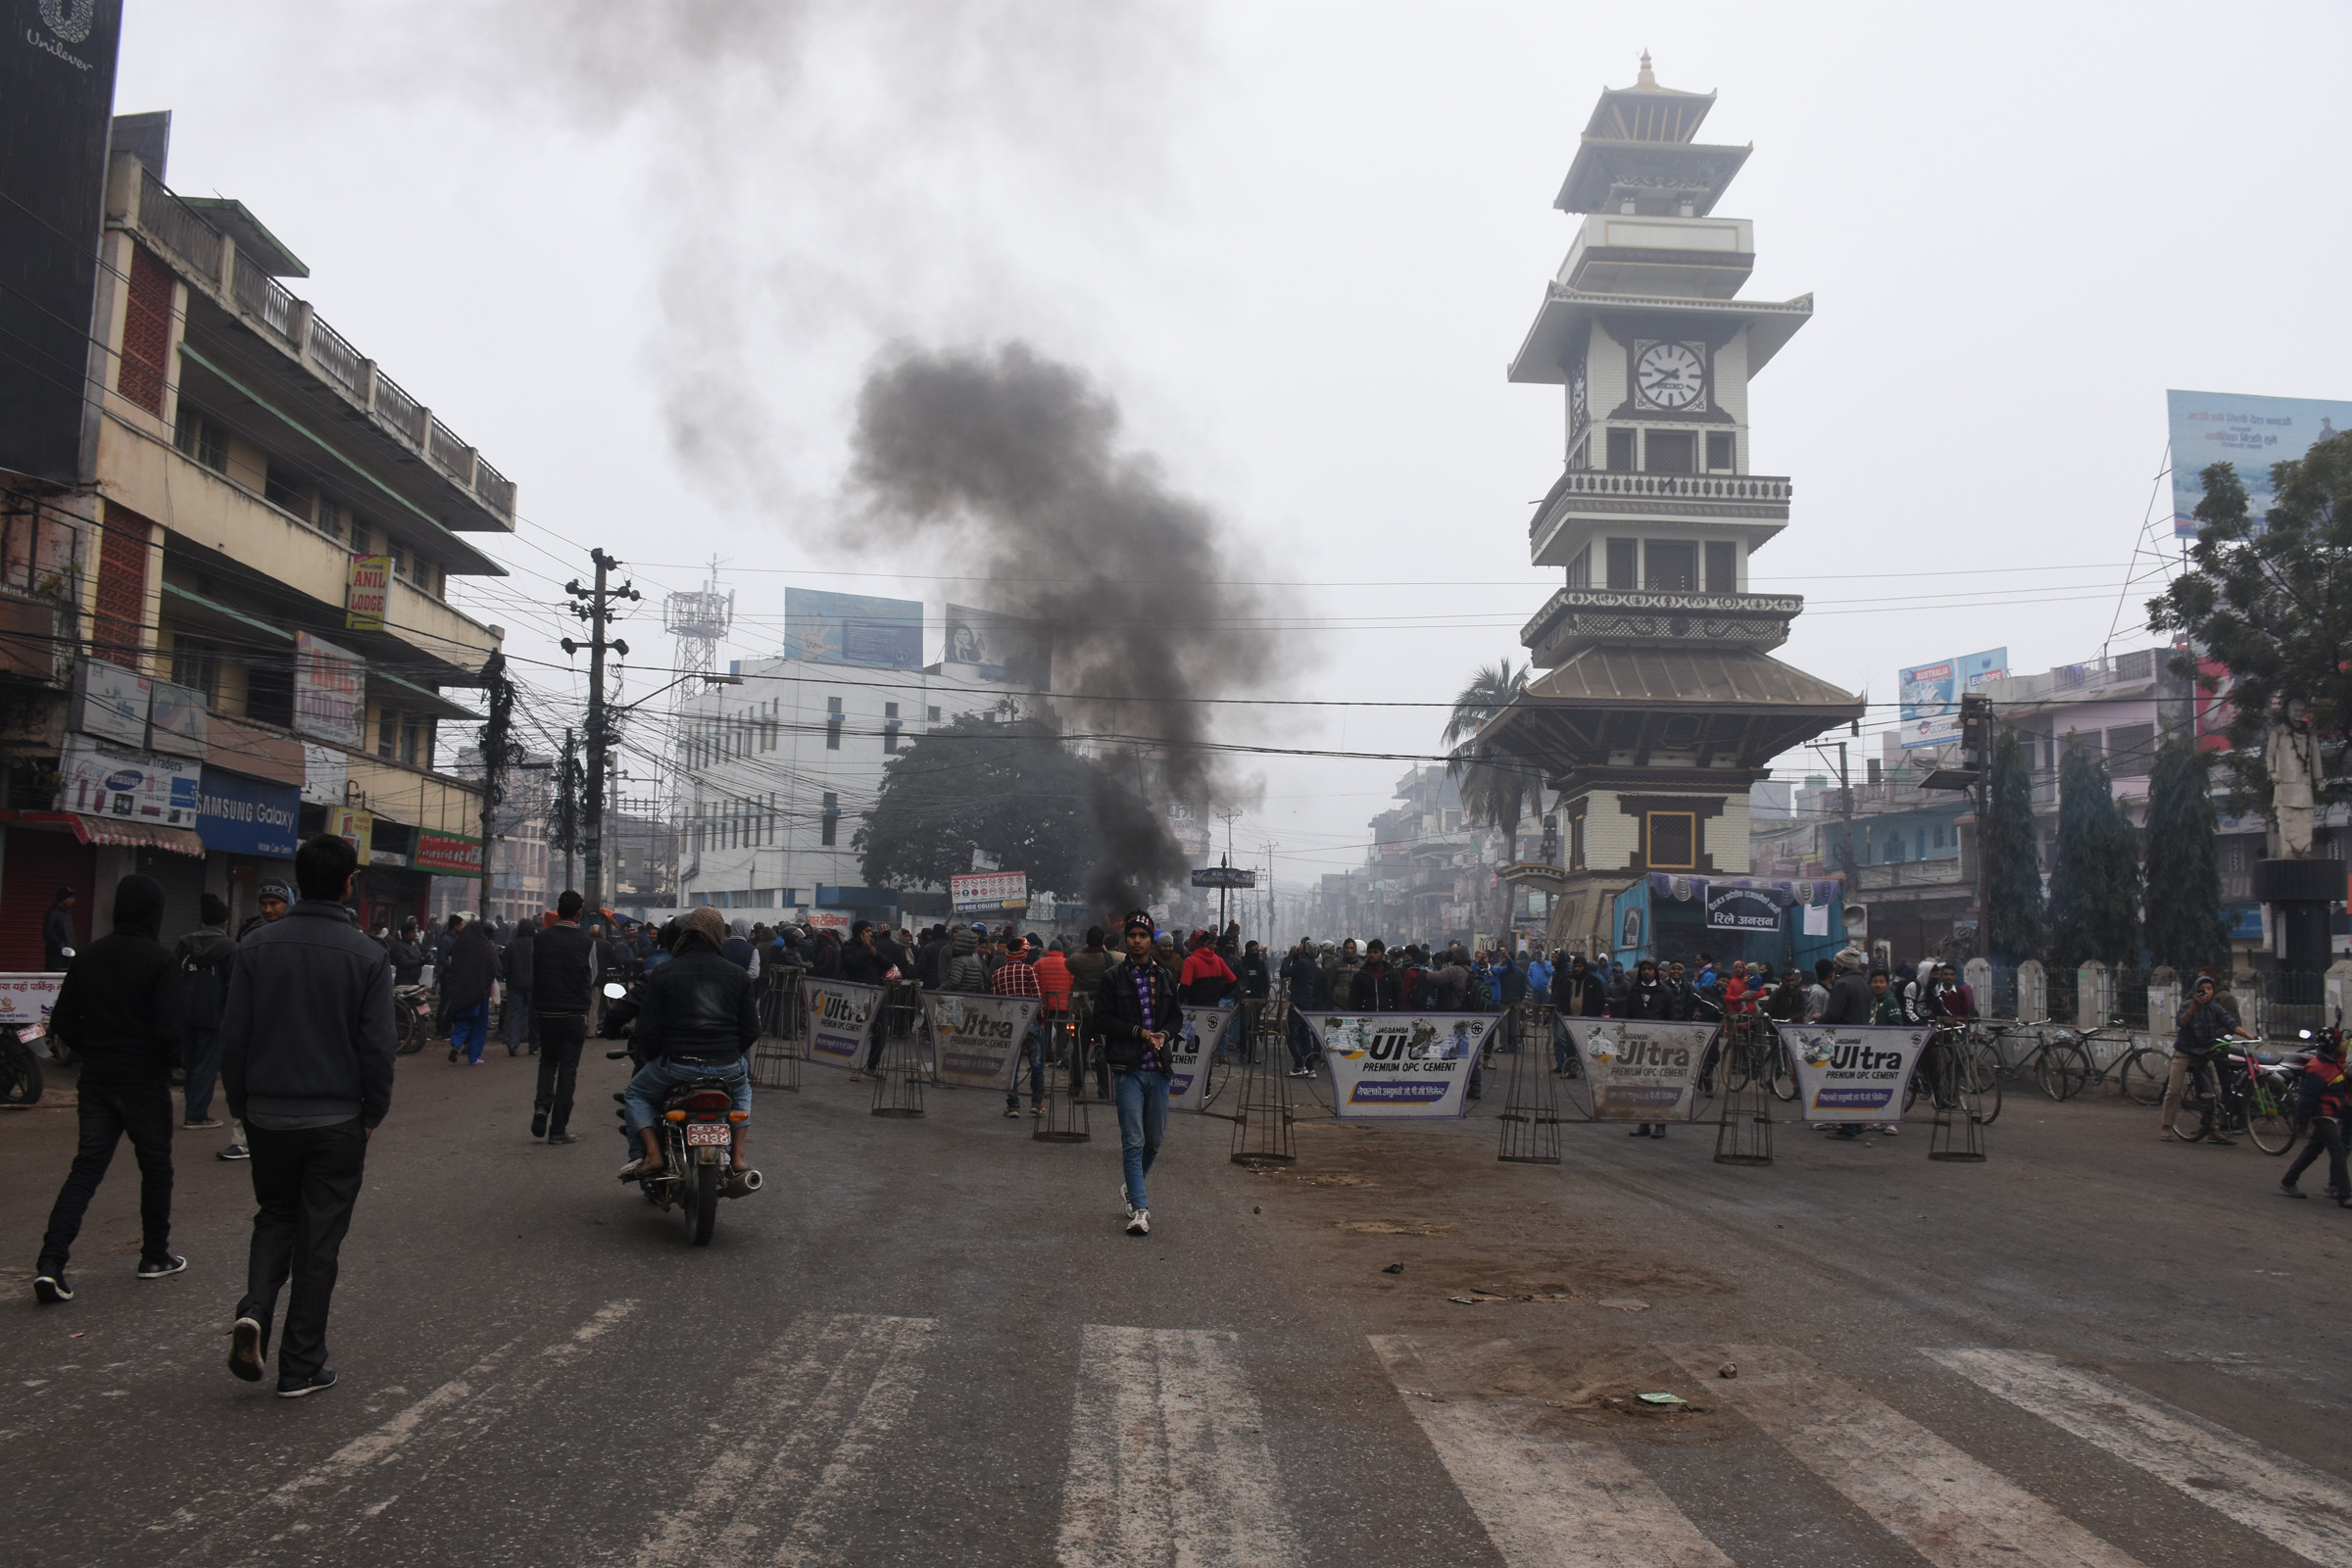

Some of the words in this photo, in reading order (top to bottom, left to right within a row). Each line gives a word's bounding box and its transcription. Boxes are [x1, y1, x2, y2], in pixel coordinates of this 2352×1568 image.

[26, 28, 93, 72] Unilever
[353, 570, 386, 589] ANIL
[351, 593, 385, 612] LODGE
[310, 647, 355, 698] ANIL
[1916, 666, 1949, 681] AUSTRALIA
[1971, 672, 2002, 686] EUROPE
[300, 686, 355, 731] LODGE
[152, 754, 183, 772] Traders
[110, 774, 141, 787] SAMSUNG
[197, 794, 254, 823] SAMSUNG
[257, 803, 295, 834] Galaxy
[1714, 911, 1736, 925] रिले
[1738, 915, 1775, 927] अनसन
[950, 1036, 977, 1047] PREMIUM
[990, 1038, 1011, 1051] CEMENT
[1616, 1041, 1690, 1067] Ultra
[1830, 1045, 1902, 1069] Ultra
[1362, 1062, 1400, 1072] PREMIUM
[1402, 1062, 1420, 1072] OPC
[1423, 1062, 1457, 1072] CEMENT
[1610, 1067, 1642, 1077] PREMIUM
[1643, 1068, 1657, 1077] OPC
[1659, 1068, 1689, 1078] CEMENT
[1826, 1070, 1855, 1079] PREMIUM
[1856, 1070, 1870, 1079] OPC
[1872, 1071, 1899, 1080] CEMENT
